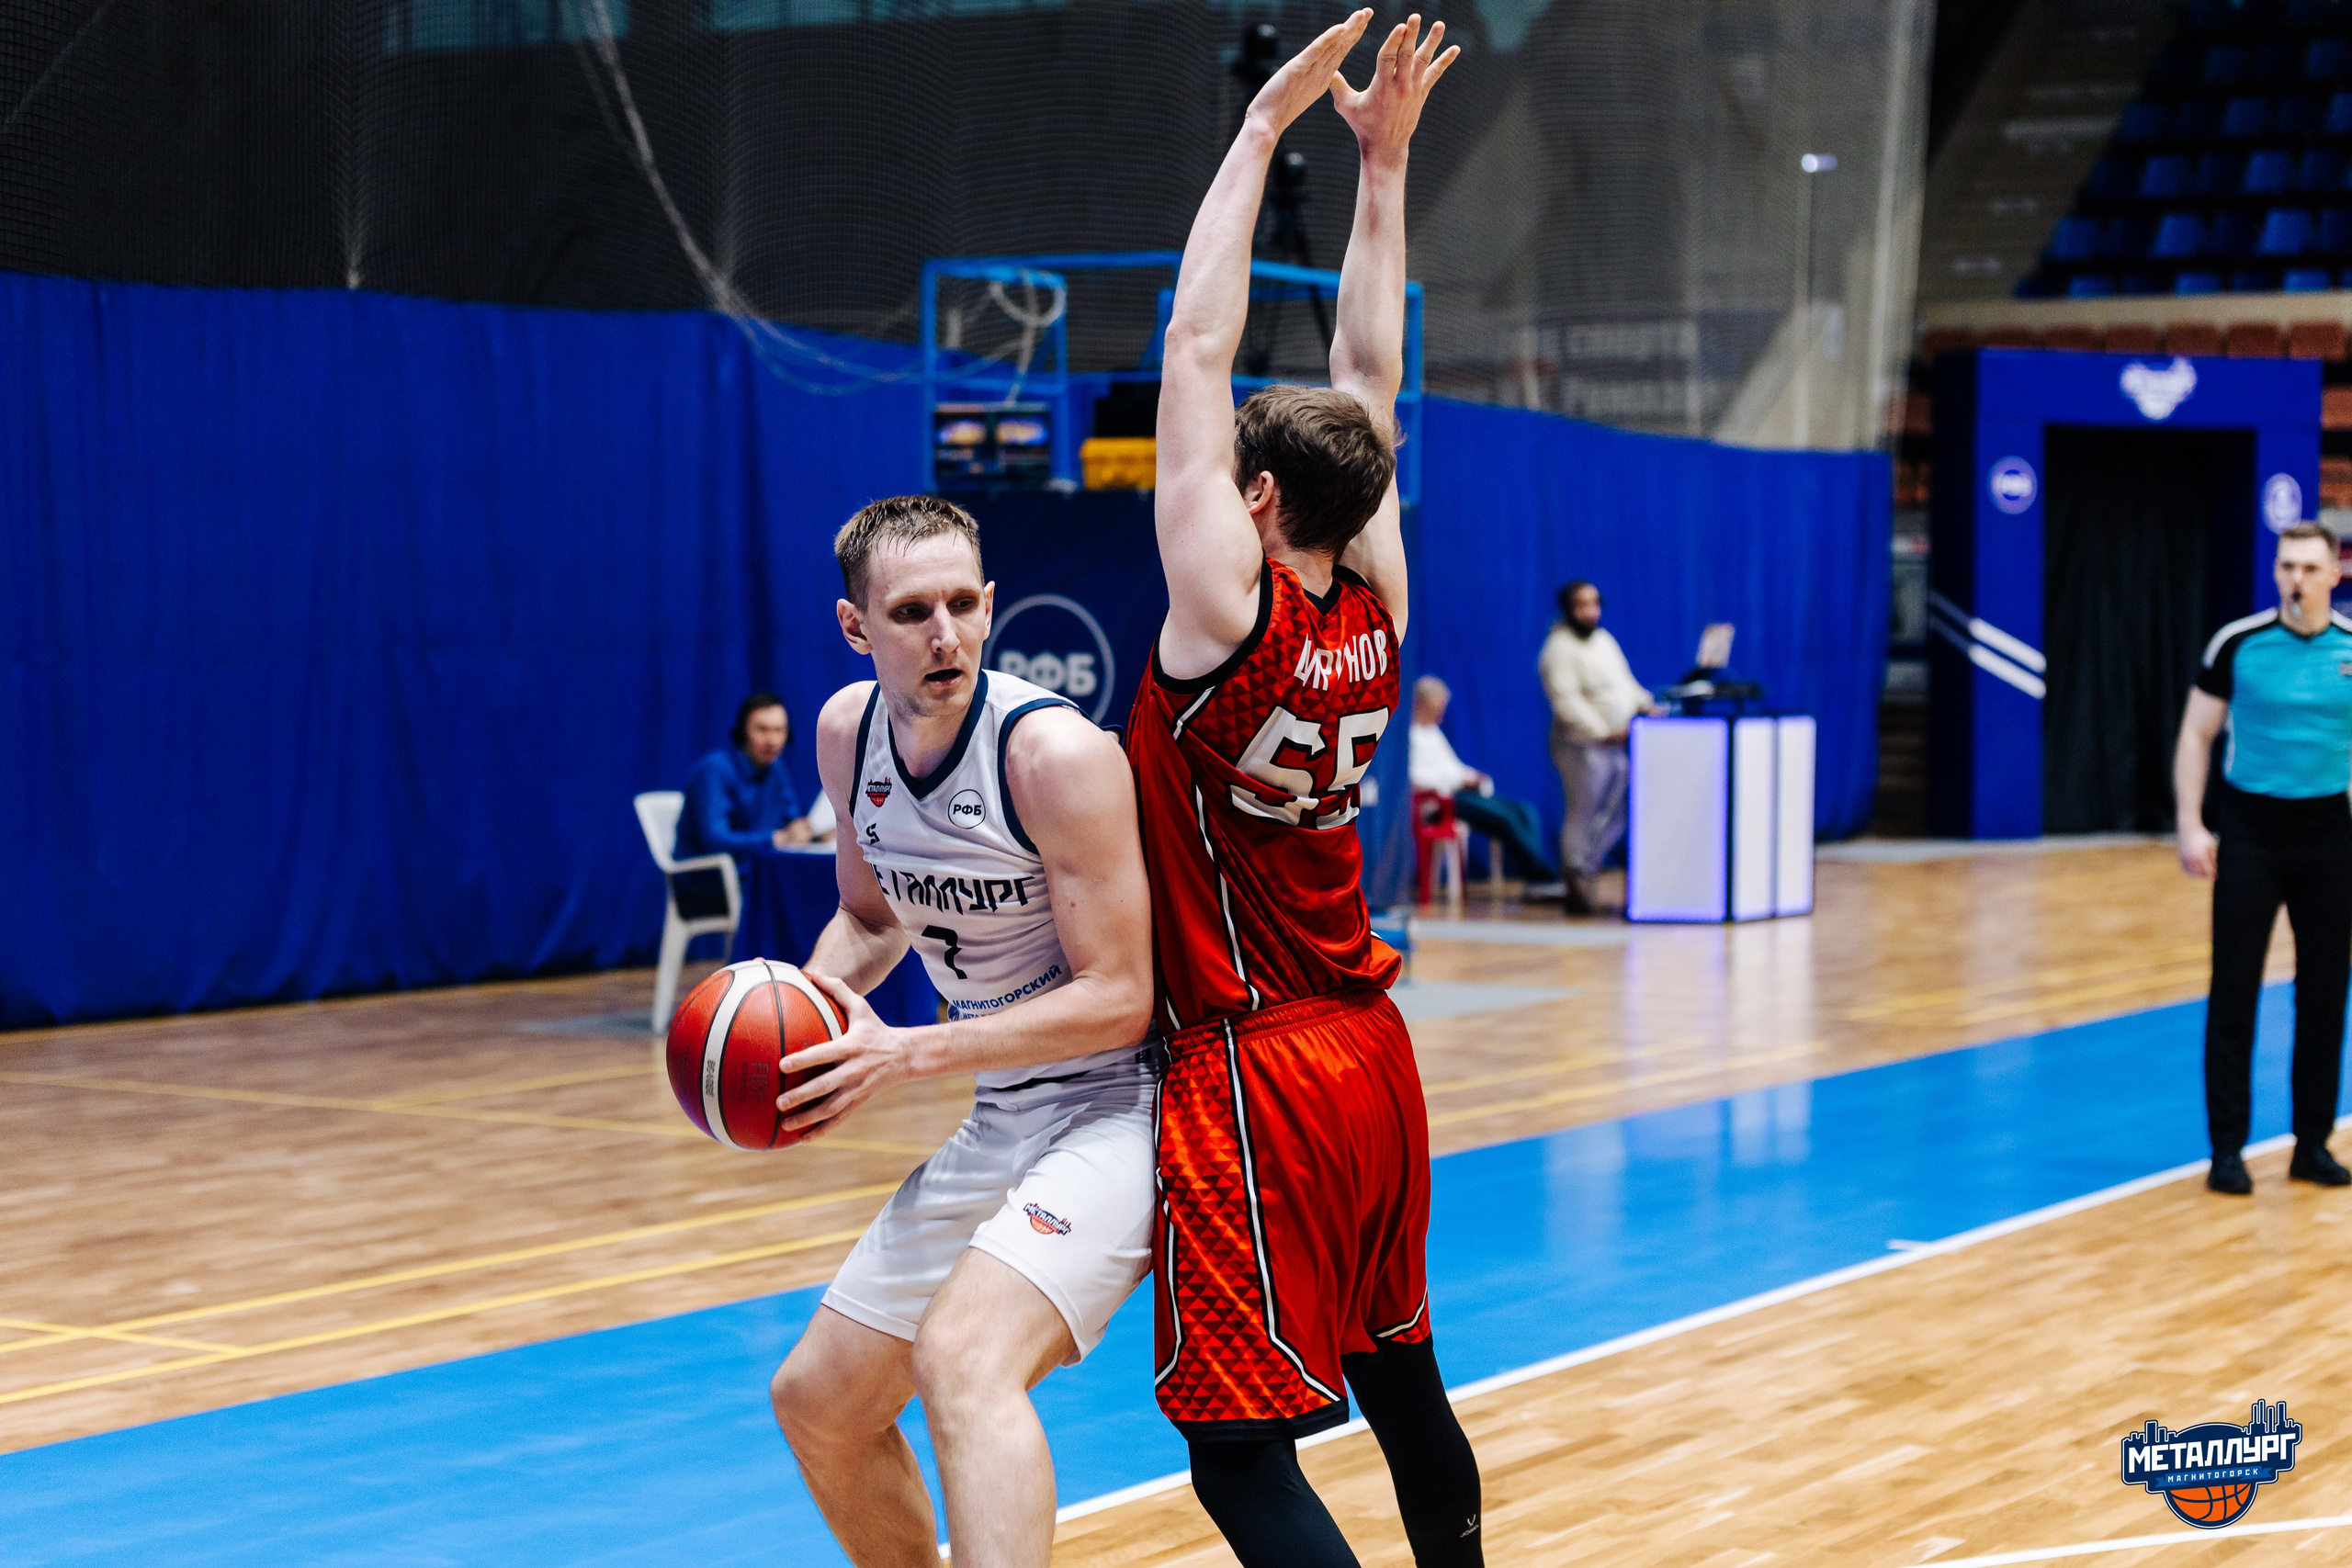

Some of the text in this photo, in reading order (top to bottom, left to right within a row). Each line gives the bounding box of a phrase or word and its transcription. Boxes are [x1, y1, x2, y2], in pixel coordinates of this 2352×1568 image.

[999, 650, 1097, 696] РФБ
[953, 804, 982, 816] РФБ
[922, 925, 967, 979] 7
